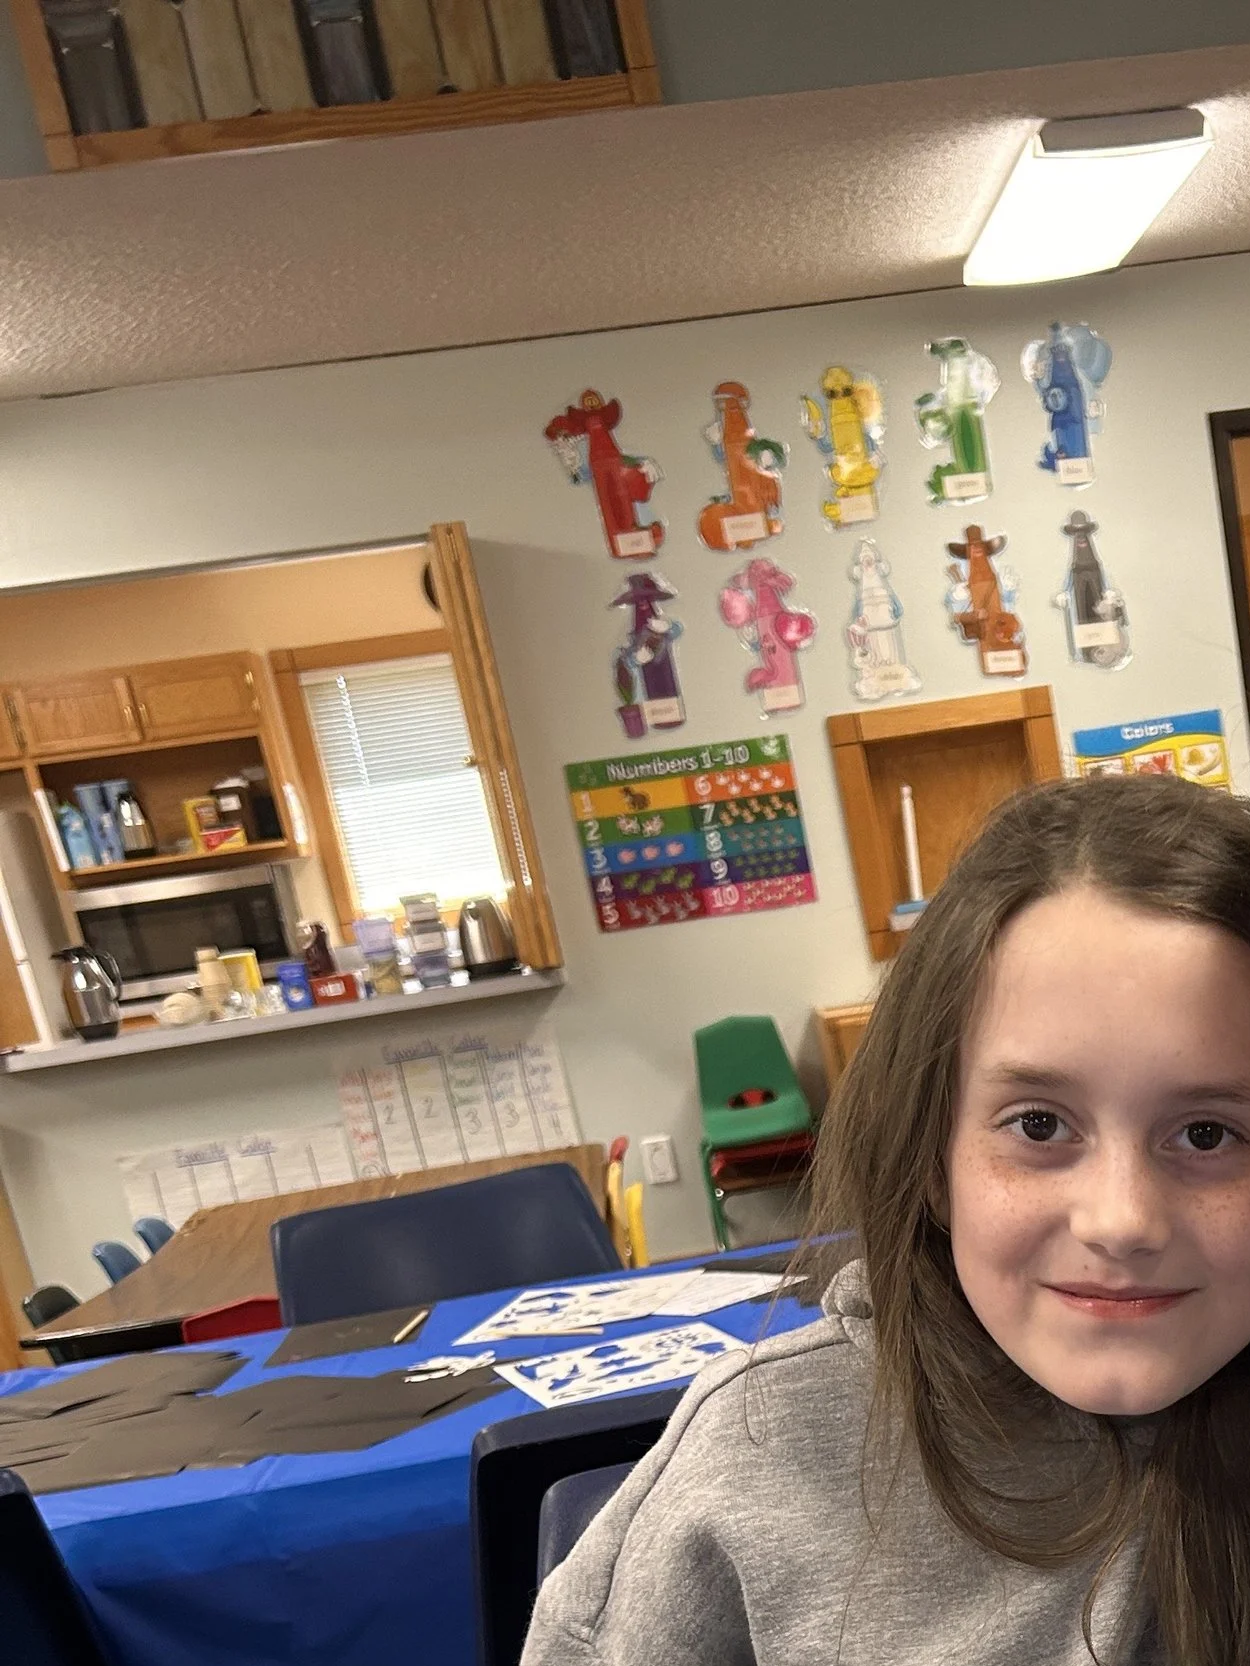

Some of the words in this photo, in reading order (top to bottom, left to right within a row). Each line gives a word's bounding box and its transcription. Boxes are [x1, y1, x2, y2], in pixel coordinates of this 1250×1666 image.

[1121, 721, 1175, 740] Colors
[606, 755, 699, 782] Numbers
[700, 744, 750, 770] 1-10
[694, 773, 712, 796] 6
[581, 791, 593, 813] 1
[698, 802, 716, 825] 7
[585, 820, 602, 842] 2
[705, 830, 723, 852] 8
[589, 846, 608, 869] 3
[710, 858, 729, 880] 9
[597, 875, 614, 896] 4
[711, 883, 740, 908] 10
[602, 902, 620, 924] 5
[465, 1107, 483, 1136] 3
[503, 1099, 521, 1129] 3
